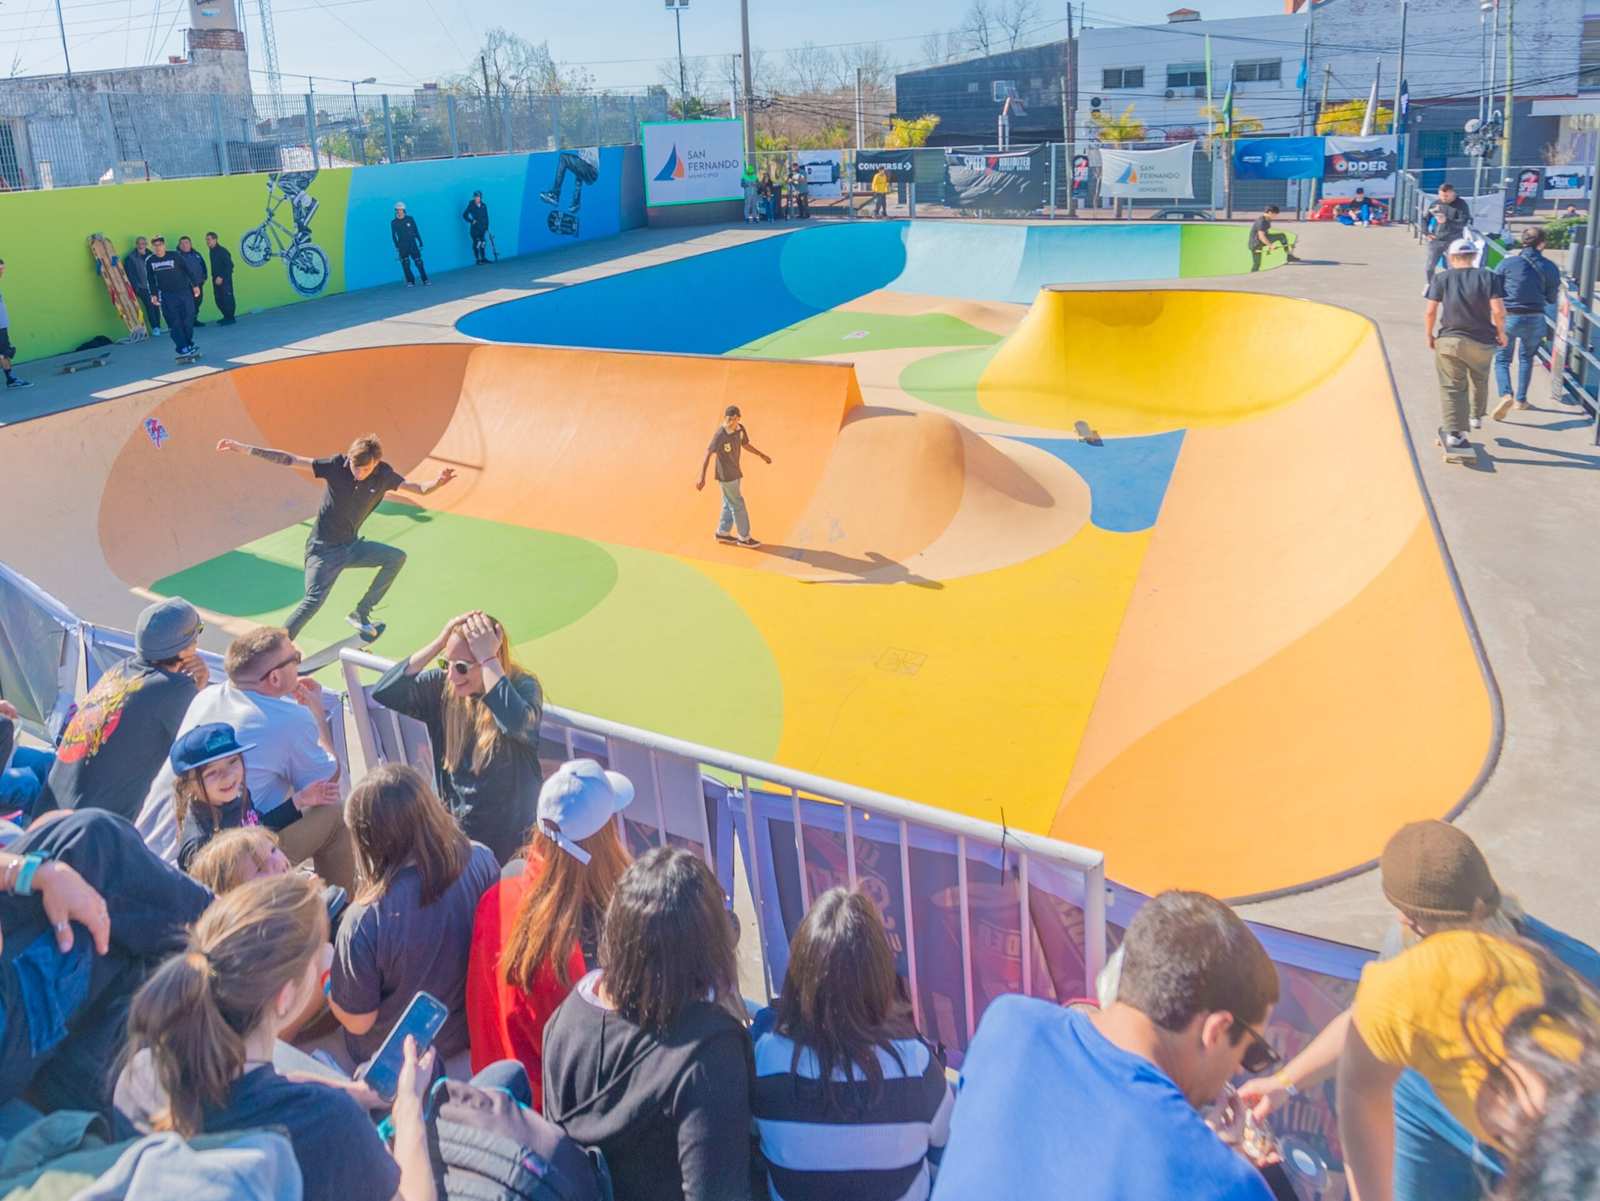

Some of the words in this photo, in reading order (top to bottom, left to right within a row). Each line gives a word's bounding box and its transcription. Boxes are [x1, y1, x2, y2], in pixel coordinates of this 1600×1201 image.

[687, 149, 706, 160] SAN
[688, 159, 739, 171] FERNANDO
[858, 161, 903, 170] CONVERSE
[963, 157, 986, 171] SPEED
[1335, 160, 1387, 172] ODDER
[1140, 171, 1180, 180] FERNANDO
